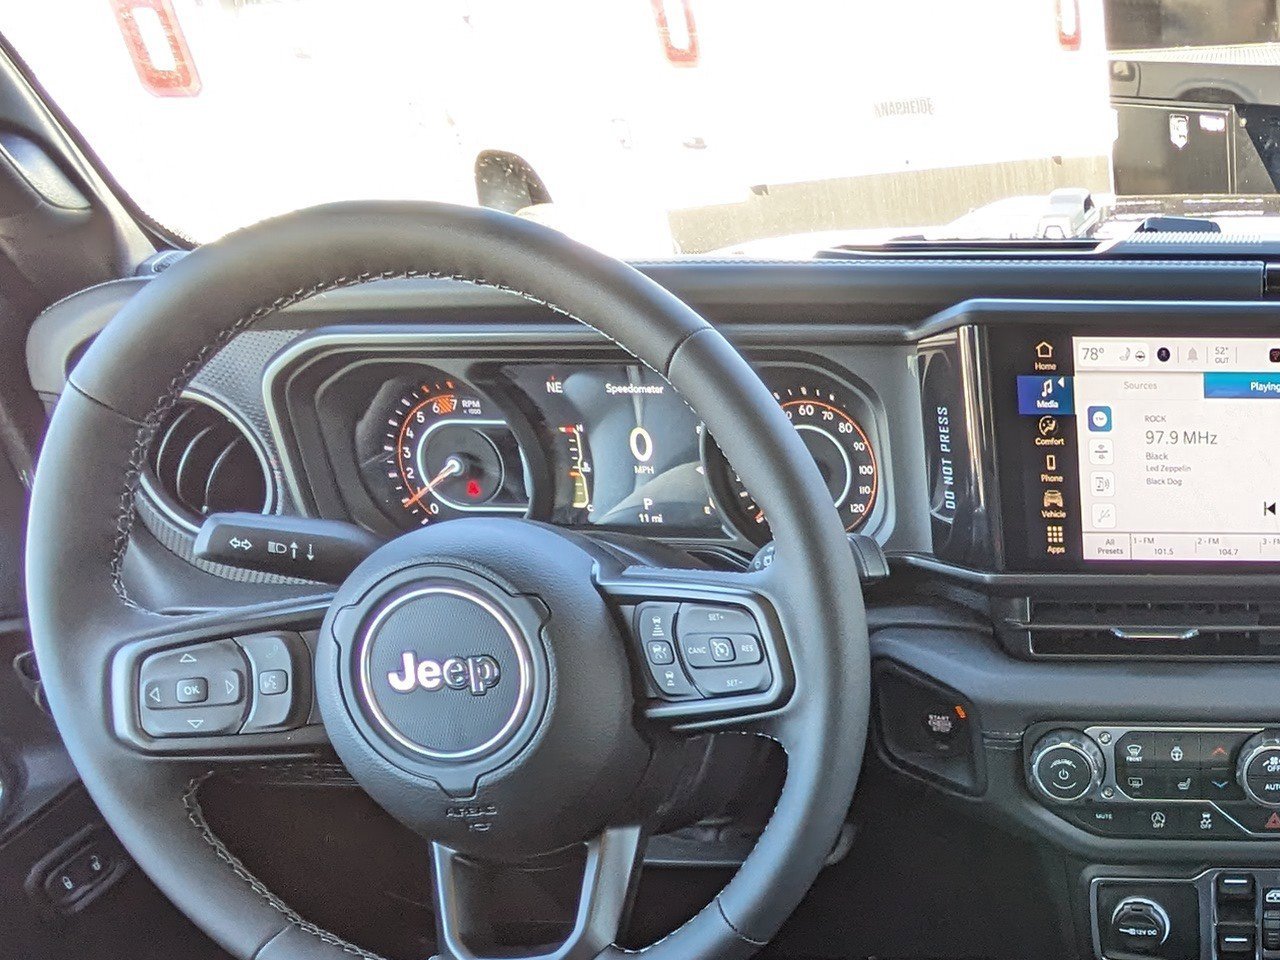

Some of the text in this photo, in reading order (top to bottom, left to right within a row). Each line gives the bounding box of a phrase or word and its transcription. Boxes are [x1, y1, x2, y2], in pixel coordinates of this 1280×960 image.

[1081, 346, 1104, 361] 78°
[1035, 361, 1057, 371] Home
[546, 381, 563, 394] NE
[605, 383, 665, 395] Speedometer
[1123, 381, 1158, 390] Sources
[432, 402, 440, 414] 6
[461, 400, 481, 408] RPM
[1036, 400, 1059, 409] Media
[798, 404, 815, 416] 60
[416, 411, 425, 424] 5
[821, 410, 834, 421] 70
[1144, 415, 1167, 423] ROCK
[405, 427, 415, 439] 4
[838, 422, 854, 434] 80
[1035, 437, 1065, 446] Comfort
[1145, 430, 1218, 445] 97.9 MHz
[629, 426, 653, 462] 0
[853, 442, 866, 452] 90
[403, 446, 412, 458] 3
[1145, 452, 1169, 461] Black
[936, 406, 956, 510] DO NOT PRESS
[406, 467, 415, 479] 2
[634, 466, 655, 475] MPH
[858, 465, 874, 476] 100
[1145, 464, 1192, 474] Led Zeppelin
[1040, 474, 1064, 483] Phone
[1146, 478, 1183, 487] Black Dog
[859, 486, 871, 495] 110
[643, 497, 653, 510] P
[850, 503, 865, 513] 120
[429, 503, 439, 515] 0
[638, 513, 663, 523] 11 mi
[1041, 510, 1067, 519] Vehicle
[1105, 538, 1115, 546] All
[1046, 545, 1066, 555] Apps
[1097, 547, 1124, 555] Presets
[1218, 548, 1239, 556] 104.7
[688, 646, 707, 655] CANC
[741, 644, 754, 652] RES
[386, 651, 501, 697] Jeep
[183, 684, 200, 696] OK
[1152, 821, 1165, 829] OFF
[1200, 822, 1212, 830] OFF
